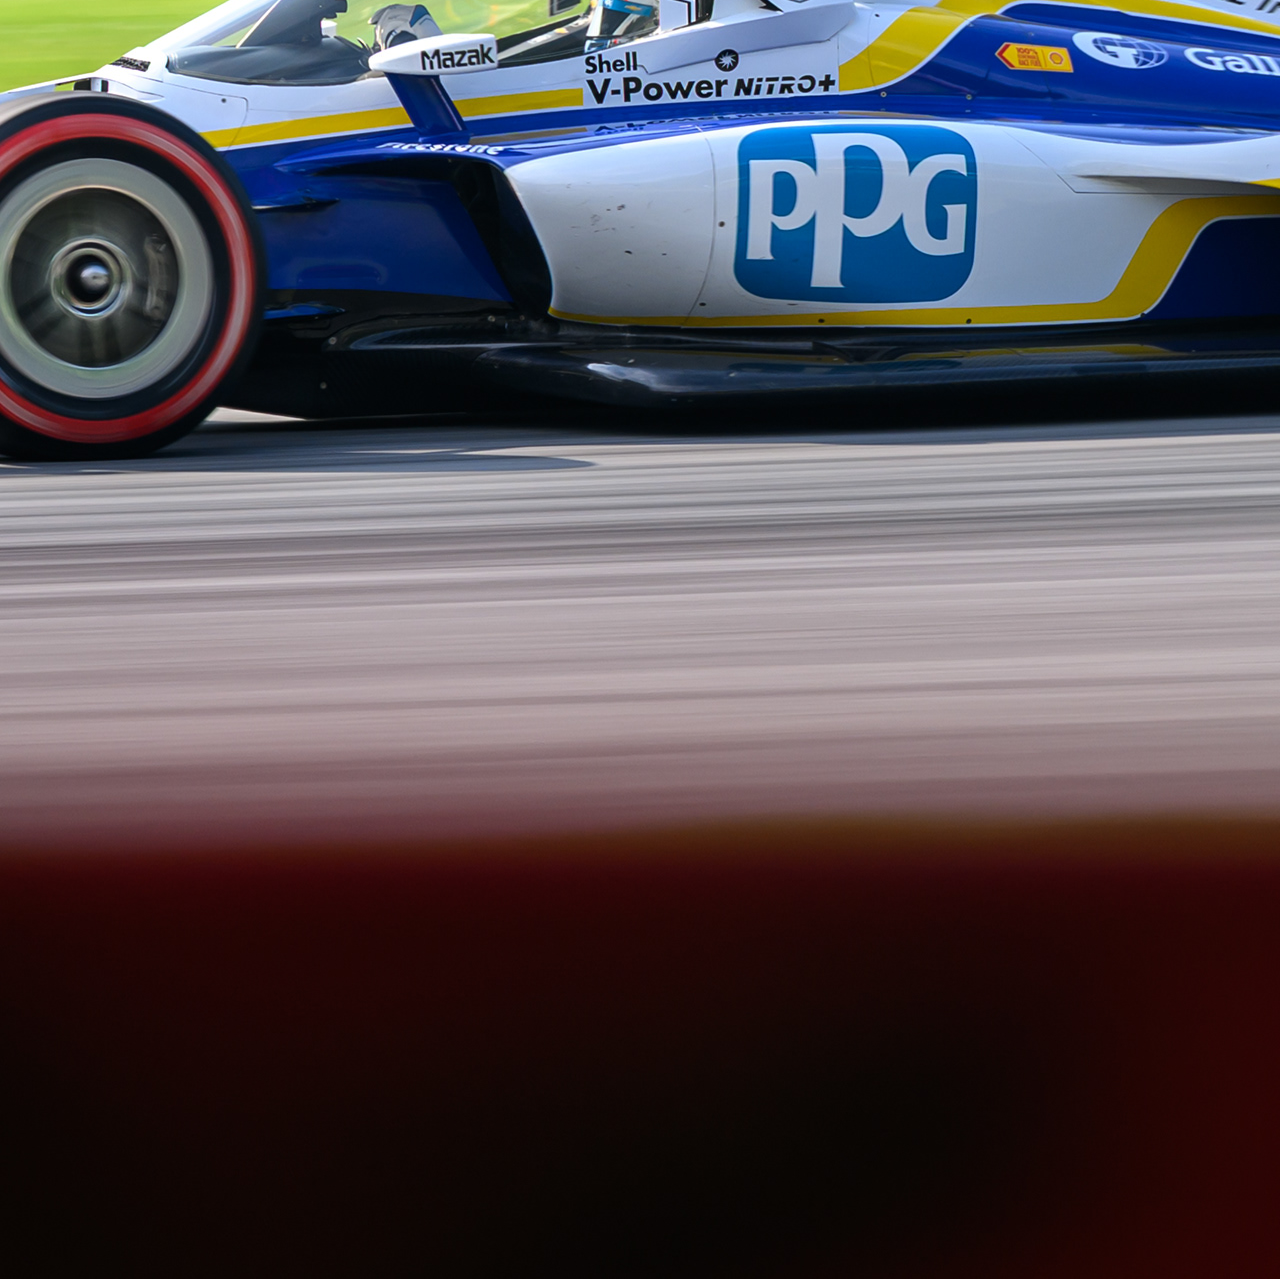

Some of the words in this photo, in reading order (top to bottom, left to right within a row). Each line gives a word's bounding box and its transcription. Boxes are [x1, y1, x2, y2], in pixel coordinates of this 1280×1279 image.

[421, 44, 495, 70] Mazak
[585, 51, 638, 74] Shell
[586, 76, 728, 105] V-Power
[375, 142, 504, 155] Firestone
[747, 132, 969, 288] PPG
